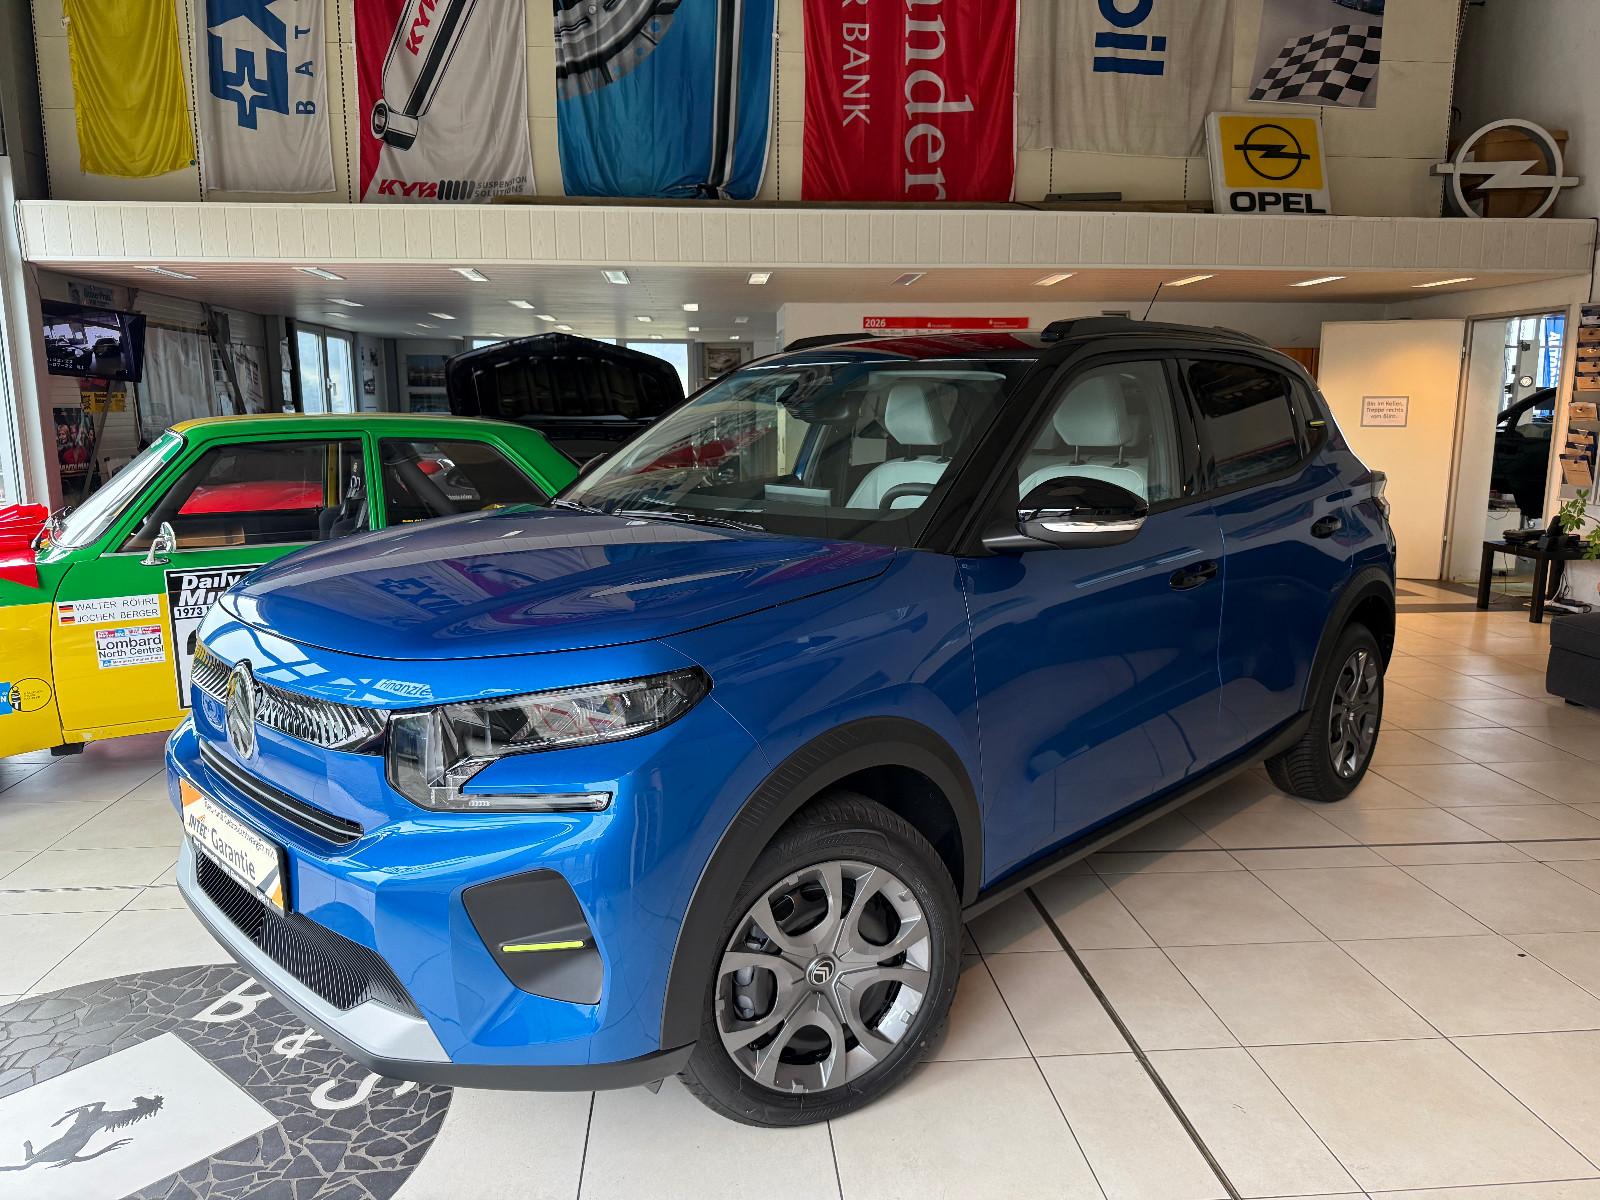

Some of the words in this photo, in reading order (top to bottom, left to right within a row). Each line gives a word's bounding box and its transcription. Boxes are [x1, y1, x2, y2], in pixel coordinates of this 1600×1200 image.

[294, 0, 316, 115] BAT
[842, 22, 871, 128] BANK
[377, 178, 439, 199] KYB
[1229, 191, 1327, 214] OPEL
[865, 318, 886, 328] 2026
[181, 570, 241, 590] Daily
[75, 601, 117, 611] WALTER
[122, 597, 158, 608] RÖHRL
[176, 606, 204, 617] 1973
[77, 612, 115, 623] JOCHEN
[120, 608, 159, 619] BERGER
[96, 634, 162, 651] Lombard
[98, 649, 127, 659] North
[129, 644, 164, 656] Central
[211, 827, 256, 881] Garantie
